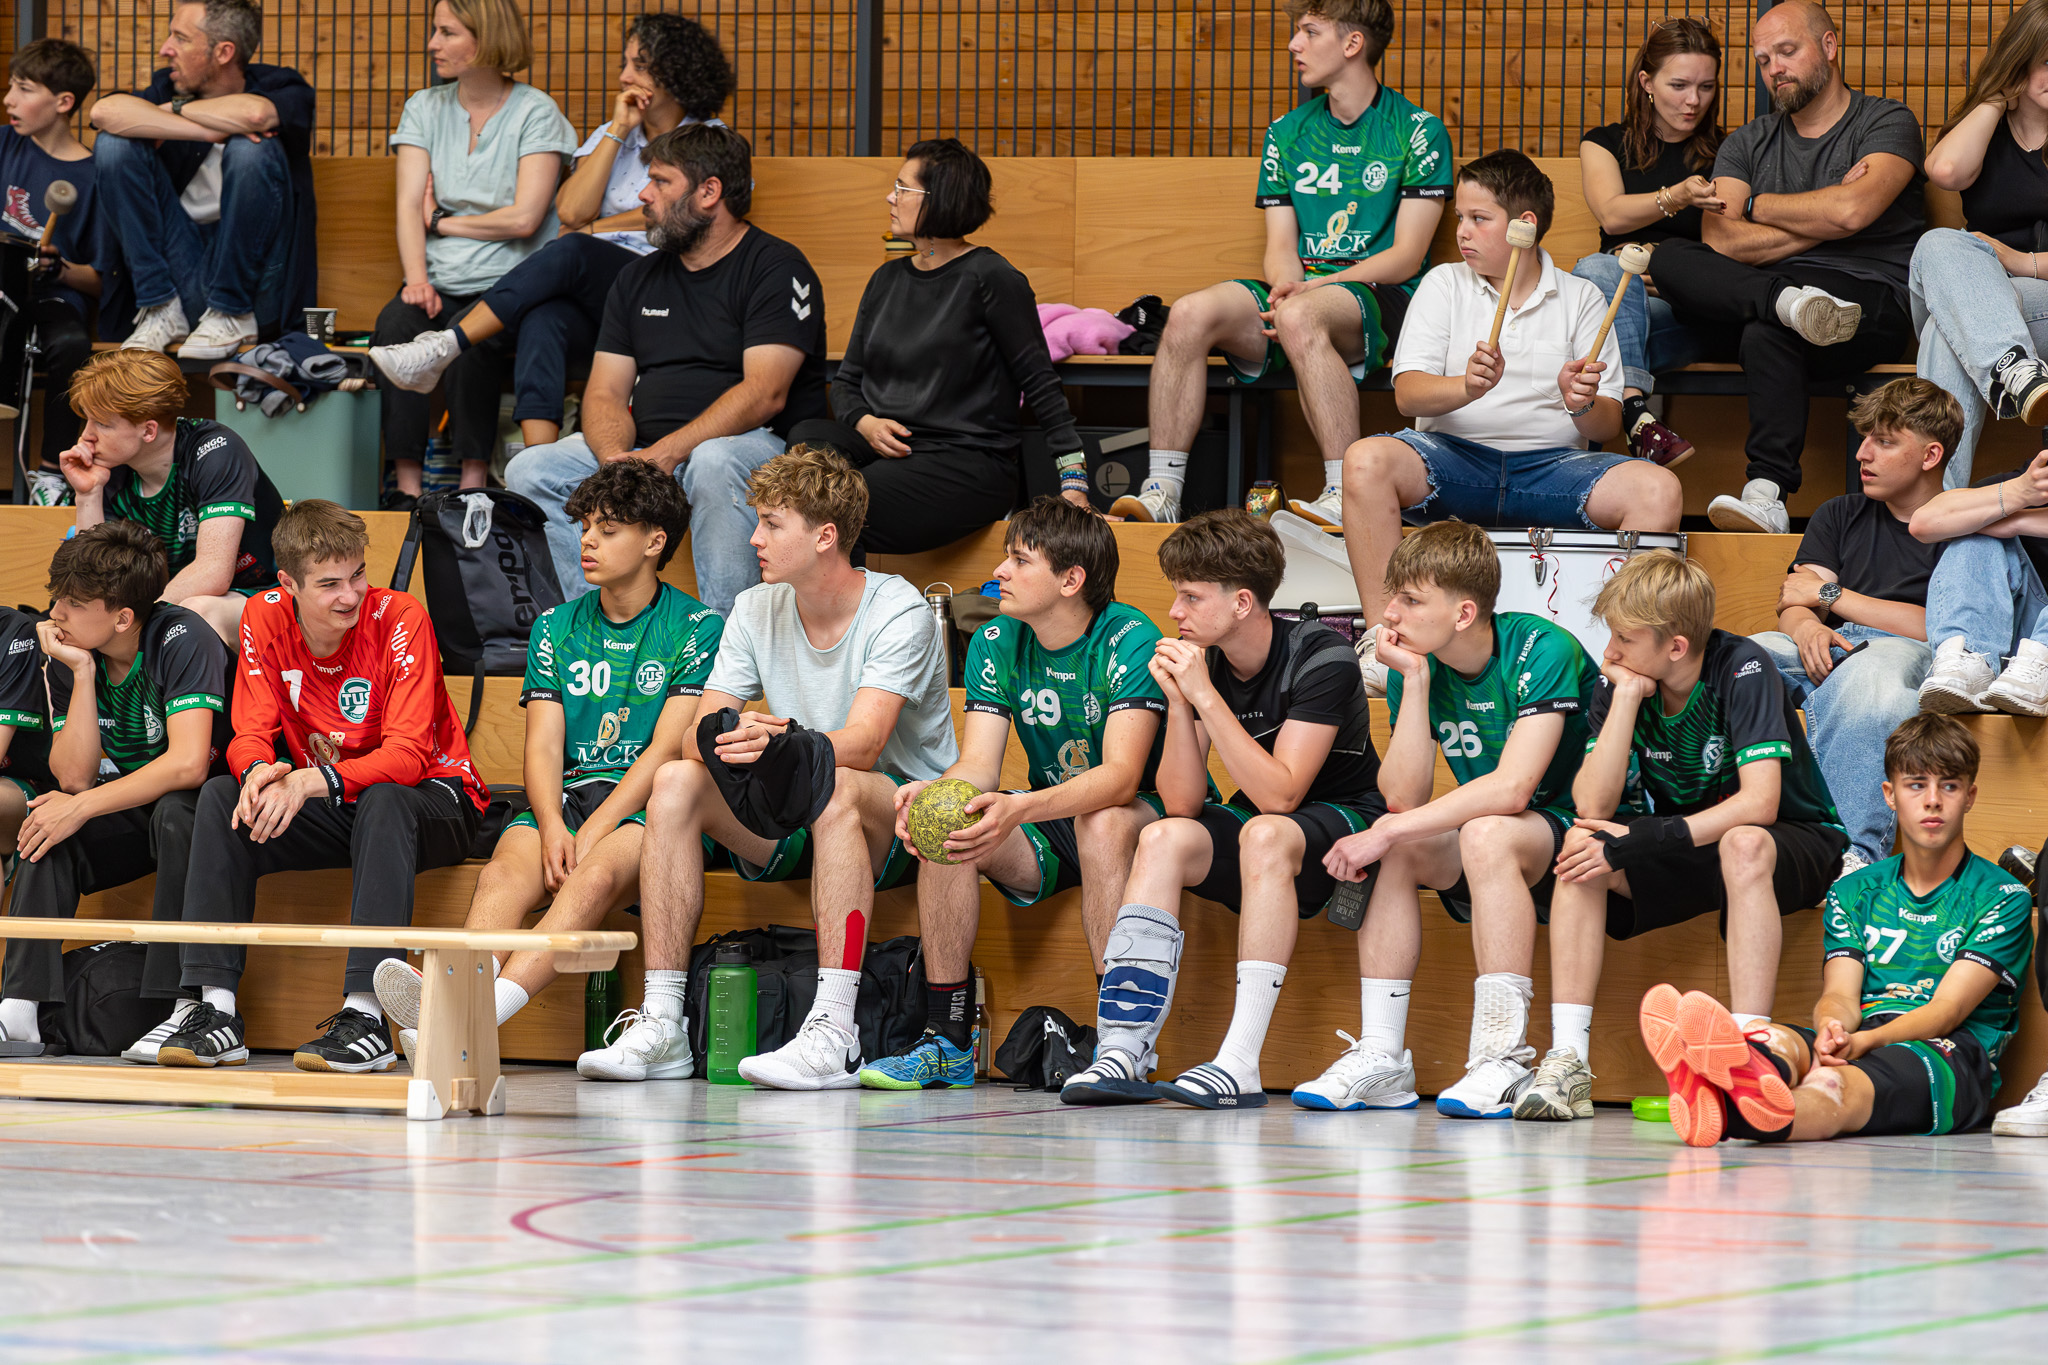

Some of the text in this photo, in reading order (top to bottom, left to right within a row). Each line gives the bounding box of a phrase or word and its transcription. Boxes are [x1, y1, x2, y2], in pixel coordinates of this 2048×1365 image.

[1331, 143, 1362, 156] Kemp
[1295, 161, 1343, 195] 24
[1364, 168, 1386, 181] TUS
[1419, 187, 1445, 197] Kempa
[207, 505, 235, 515] Kempa
[566, 660, 611, 697] 30
[639, 671, 663, 682] TUS
[172, 696, 200, 708] Kempa
[974, 703, 999, 714] Kempa
[1020, 688, 1062, 727] 29
[1466, 699, 1495, 713] Kempa
[1553, 701, 1579, 709] Kempa
[17, 713, 40, 725] Kempa
[98, 718, 116, 730] mpa
[145, 717, 158, 730] US
[1439, 720, 1483, 758] 26
[1646, 747, 1673, 762] Kemp
[1746, 746, 1776, 758] Kempa
[1898, 907, 1938, 926] Kempa
[1863, 924, 1908, 965] 27
[1942, 936, 1961, 951] TU
[1826, 950, 1850, 960] Kempa
[1963, 951, 1992, 967] Kempa
[1218, 1097, 1238, 1106] adidas
